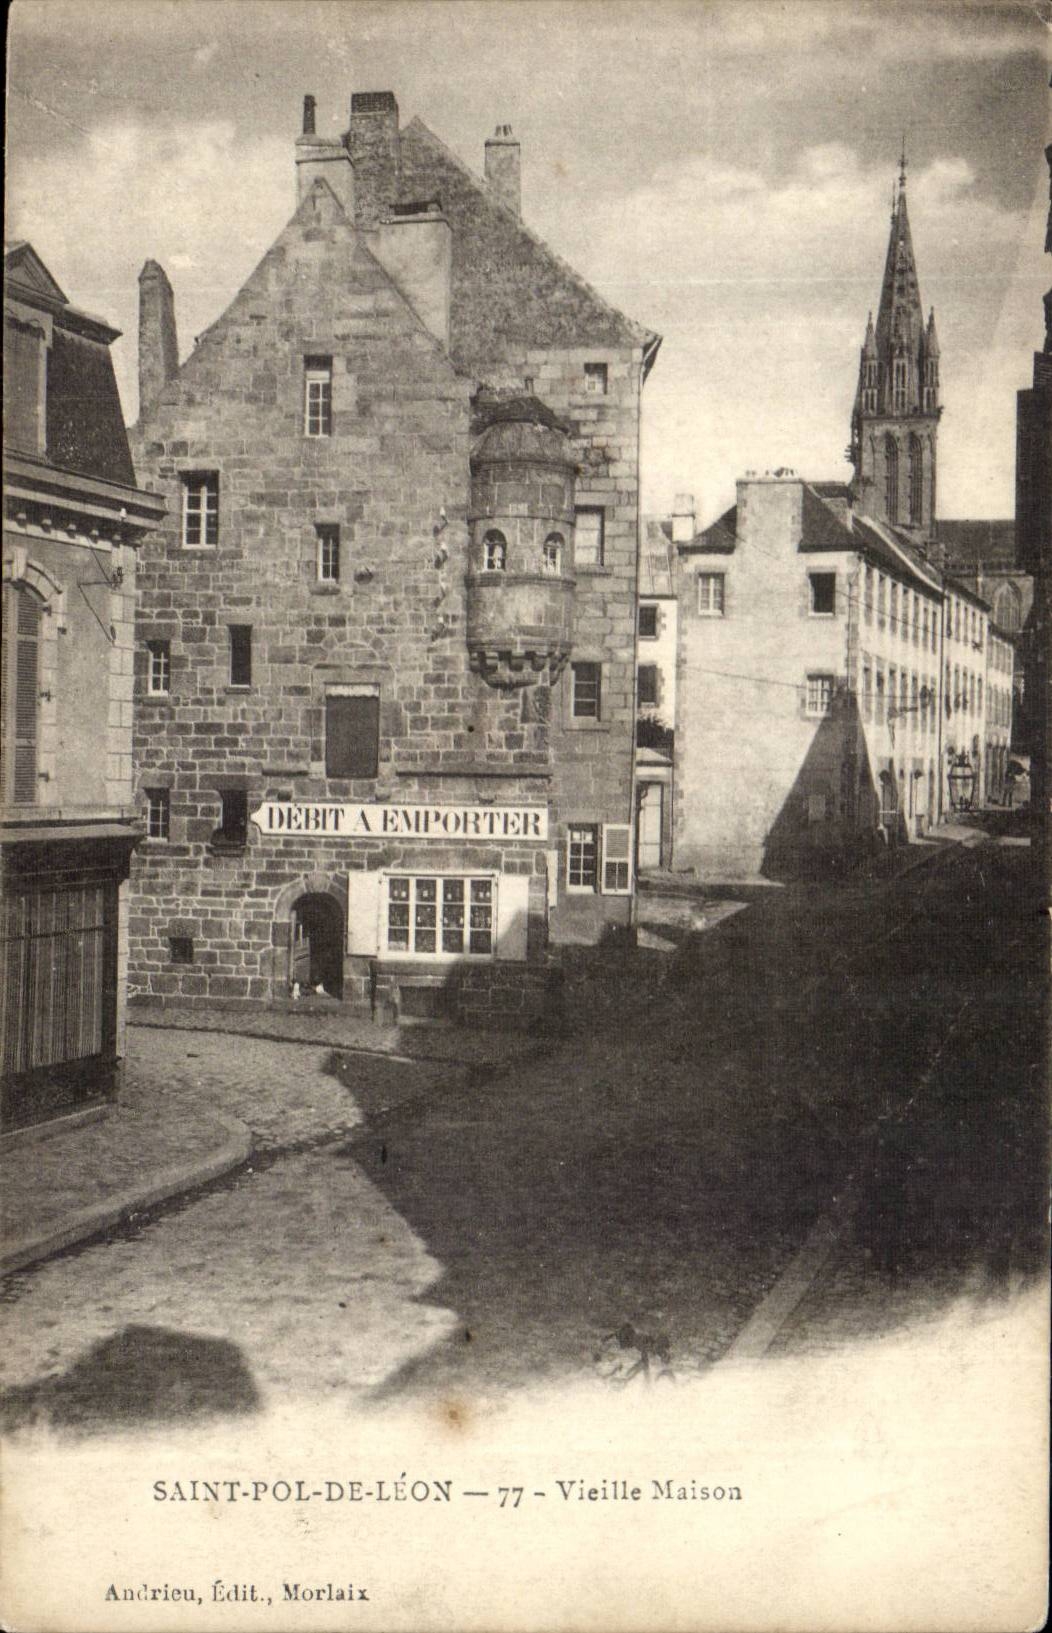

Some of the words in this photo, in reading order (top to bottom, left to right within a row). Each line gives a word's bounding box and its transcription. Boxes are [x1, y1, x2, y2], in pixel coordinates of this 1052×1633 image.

[268, 802, 345, 831] DÉBIT
[354, 807, 372, 833] A
[382, 809, 541, 836] EMPORTER
